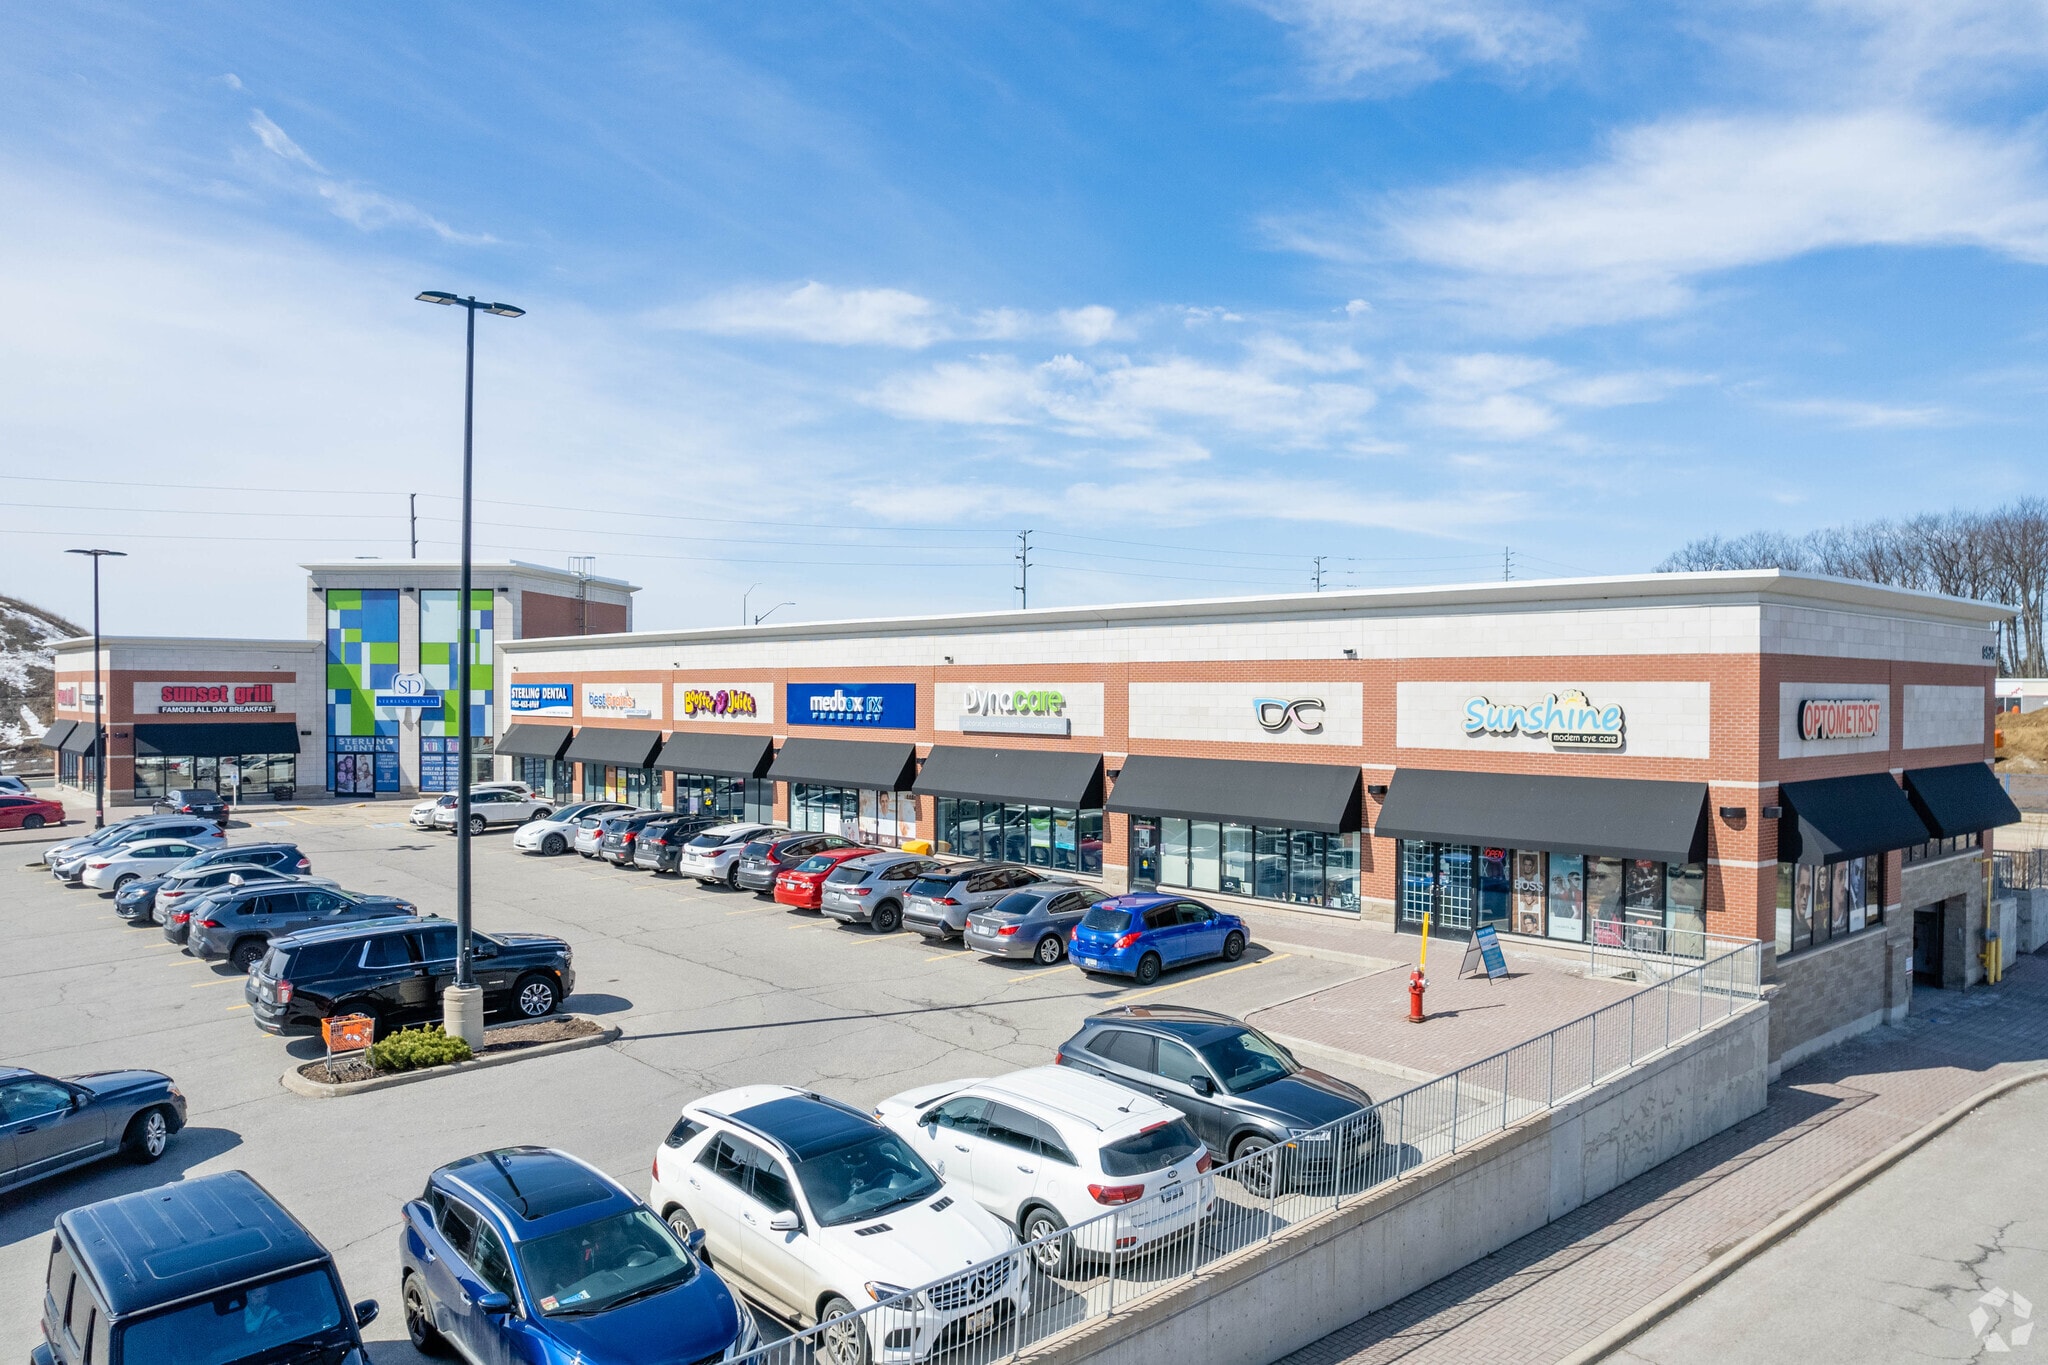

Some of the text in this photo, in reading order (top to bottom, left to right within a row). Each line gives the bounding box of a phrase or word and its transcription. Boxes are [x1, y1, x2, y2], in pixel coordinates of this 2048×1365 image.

[161, 684, 273, 704] sunset grill
[511, 687, 567, 700] STERLING DENTAL
[589, 692, 632, 707] best brains
[684, 690, 754, 714] Booster Juice
[810, 689, 883, 713] medbox rx
[964, 685, 1063, 716] Dynacare
[812, 712, 881, 721] PHARMACY
[1465, 697, 1620, 731] Sunshine
[1804, 704, 1880, 736] OPTOMETRIST
[1553, 733, 1617, 743] modern eye care
[1486, 848, 1504, 858] OPEN
[1514, 879, 1543, 892] BOSS
